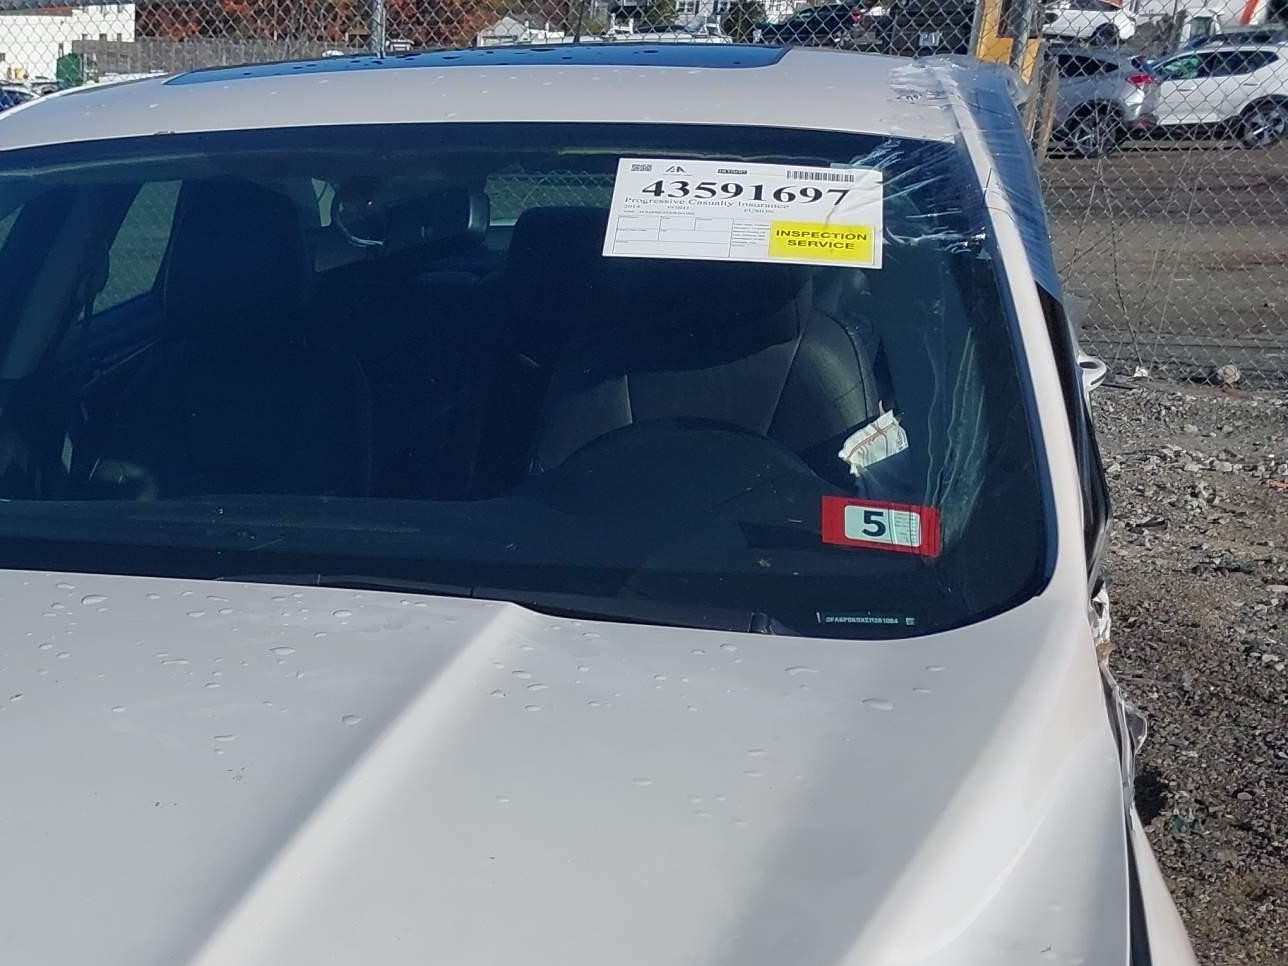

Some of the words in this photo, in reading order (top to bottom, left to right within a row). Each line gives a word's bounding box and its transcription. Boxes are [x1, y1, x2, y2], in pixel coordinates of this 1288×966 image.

[641, 180, 850, 206] 43591697
[776, 230, 867, 241] INSPECTION
[787, 240, 855, 250] SERVICE
[861, 510, 887, 537] 5
